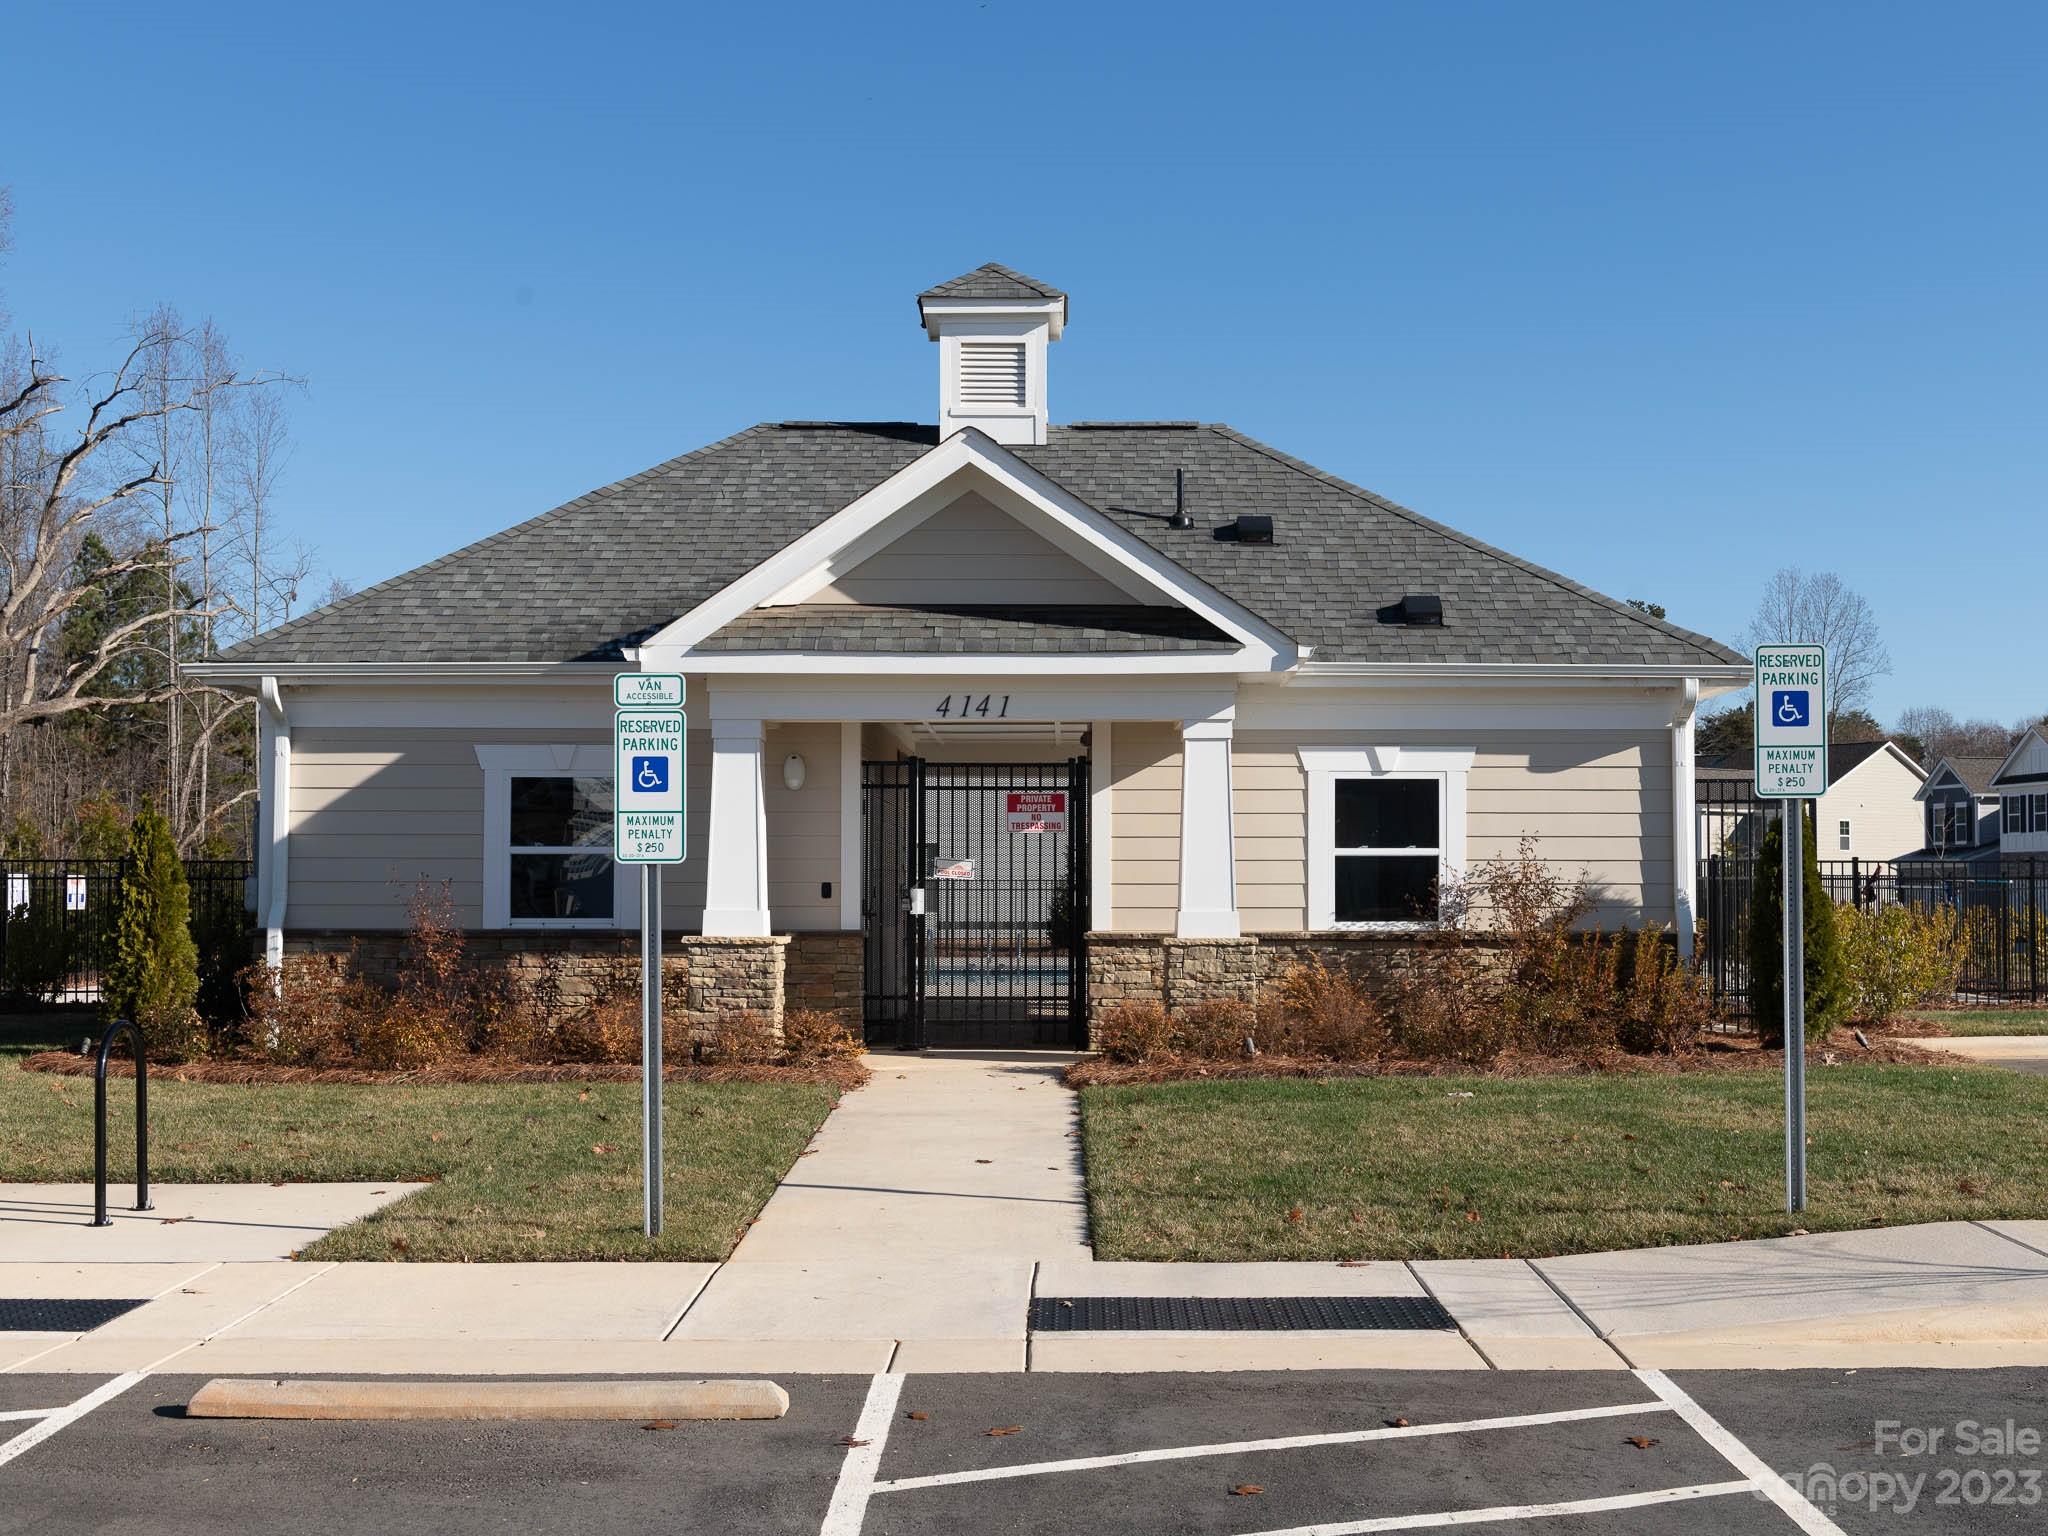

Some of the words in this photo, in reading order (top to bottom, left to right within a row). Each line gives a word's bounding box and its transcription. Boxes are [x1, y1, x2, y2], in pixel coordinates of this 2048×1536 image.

[1760, 654, 1821, 668] RESERVED
[1762, 672, 1819, 686] PARKING
[638, 681, 662, 691] VAN
[626, 692, 674, 700] ACCESSIBLE
[936, 694, 1009, 718] 4141
[620, 720, 681, 733] RESERVED
[623, 738, 678, 751] PARKING
[1767, 750, 1816, 761] MAXIMUM
[1768, 763, 1814, 774] PENALTY
[1020, 794, 1053, 803] PRIVATE
[1016, 803, 1056, 812] PROPERTY
[626, 815, 675, 826] MAXIMUM
[1031, 813, 1042, 822] NO
[1011, 822, 1062, 831] TRESPASSING
[628, 829, 673, 840] PENALTY
